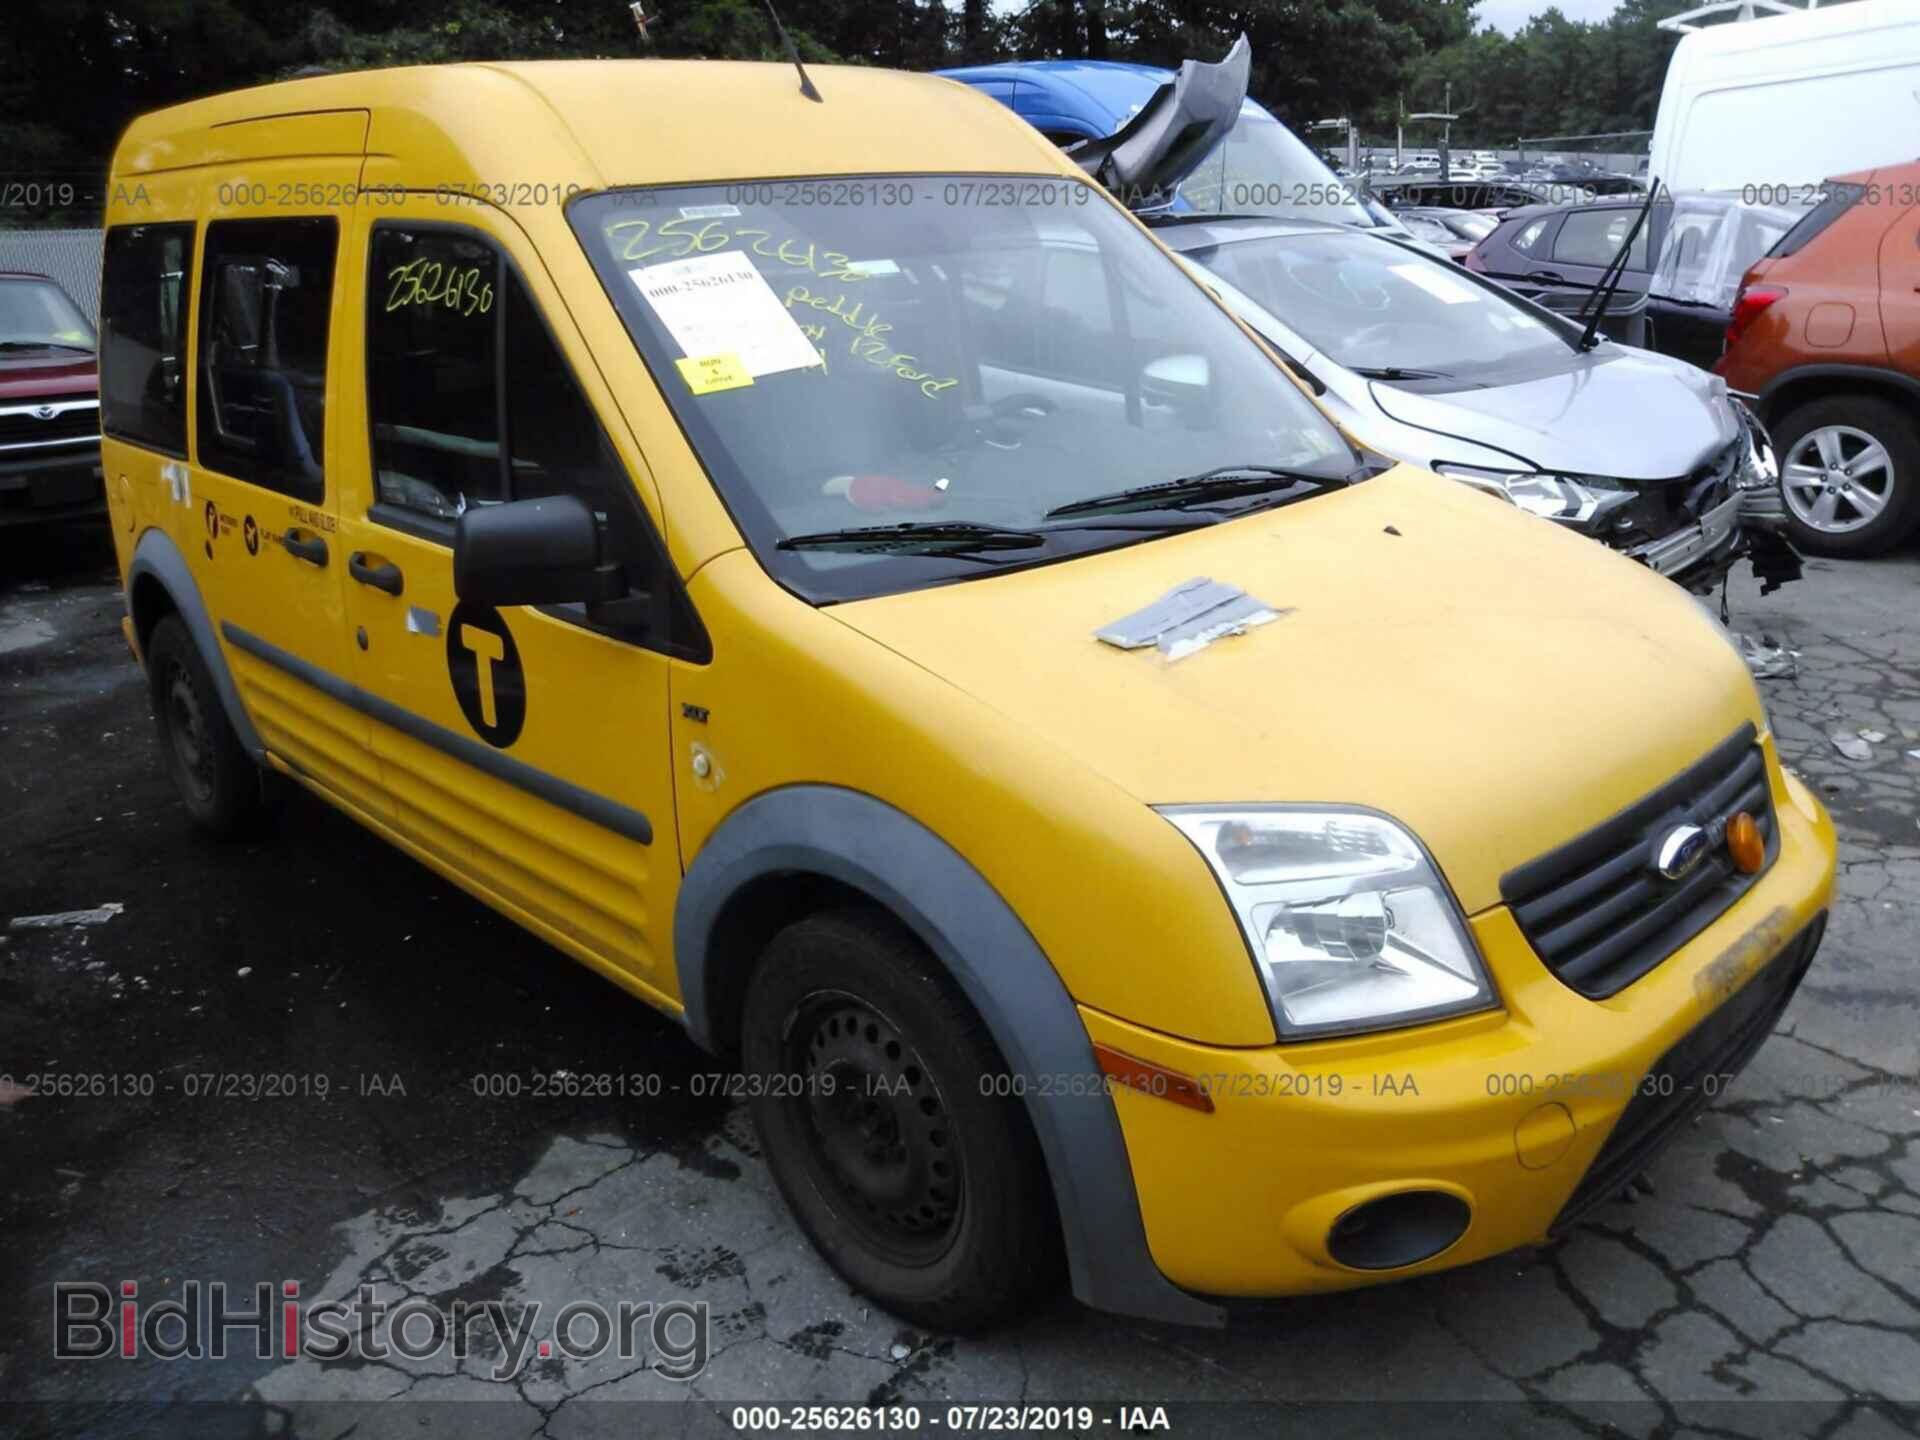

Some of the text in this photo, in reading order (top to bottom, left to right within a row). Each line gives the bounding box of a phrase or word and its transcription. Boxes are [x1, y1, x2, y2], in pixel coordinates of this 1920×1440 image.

[386, 257, 494, 316] 25626130
[649, 272, 754, 297] 000-25626130
[460, 622, 504, 729] T
